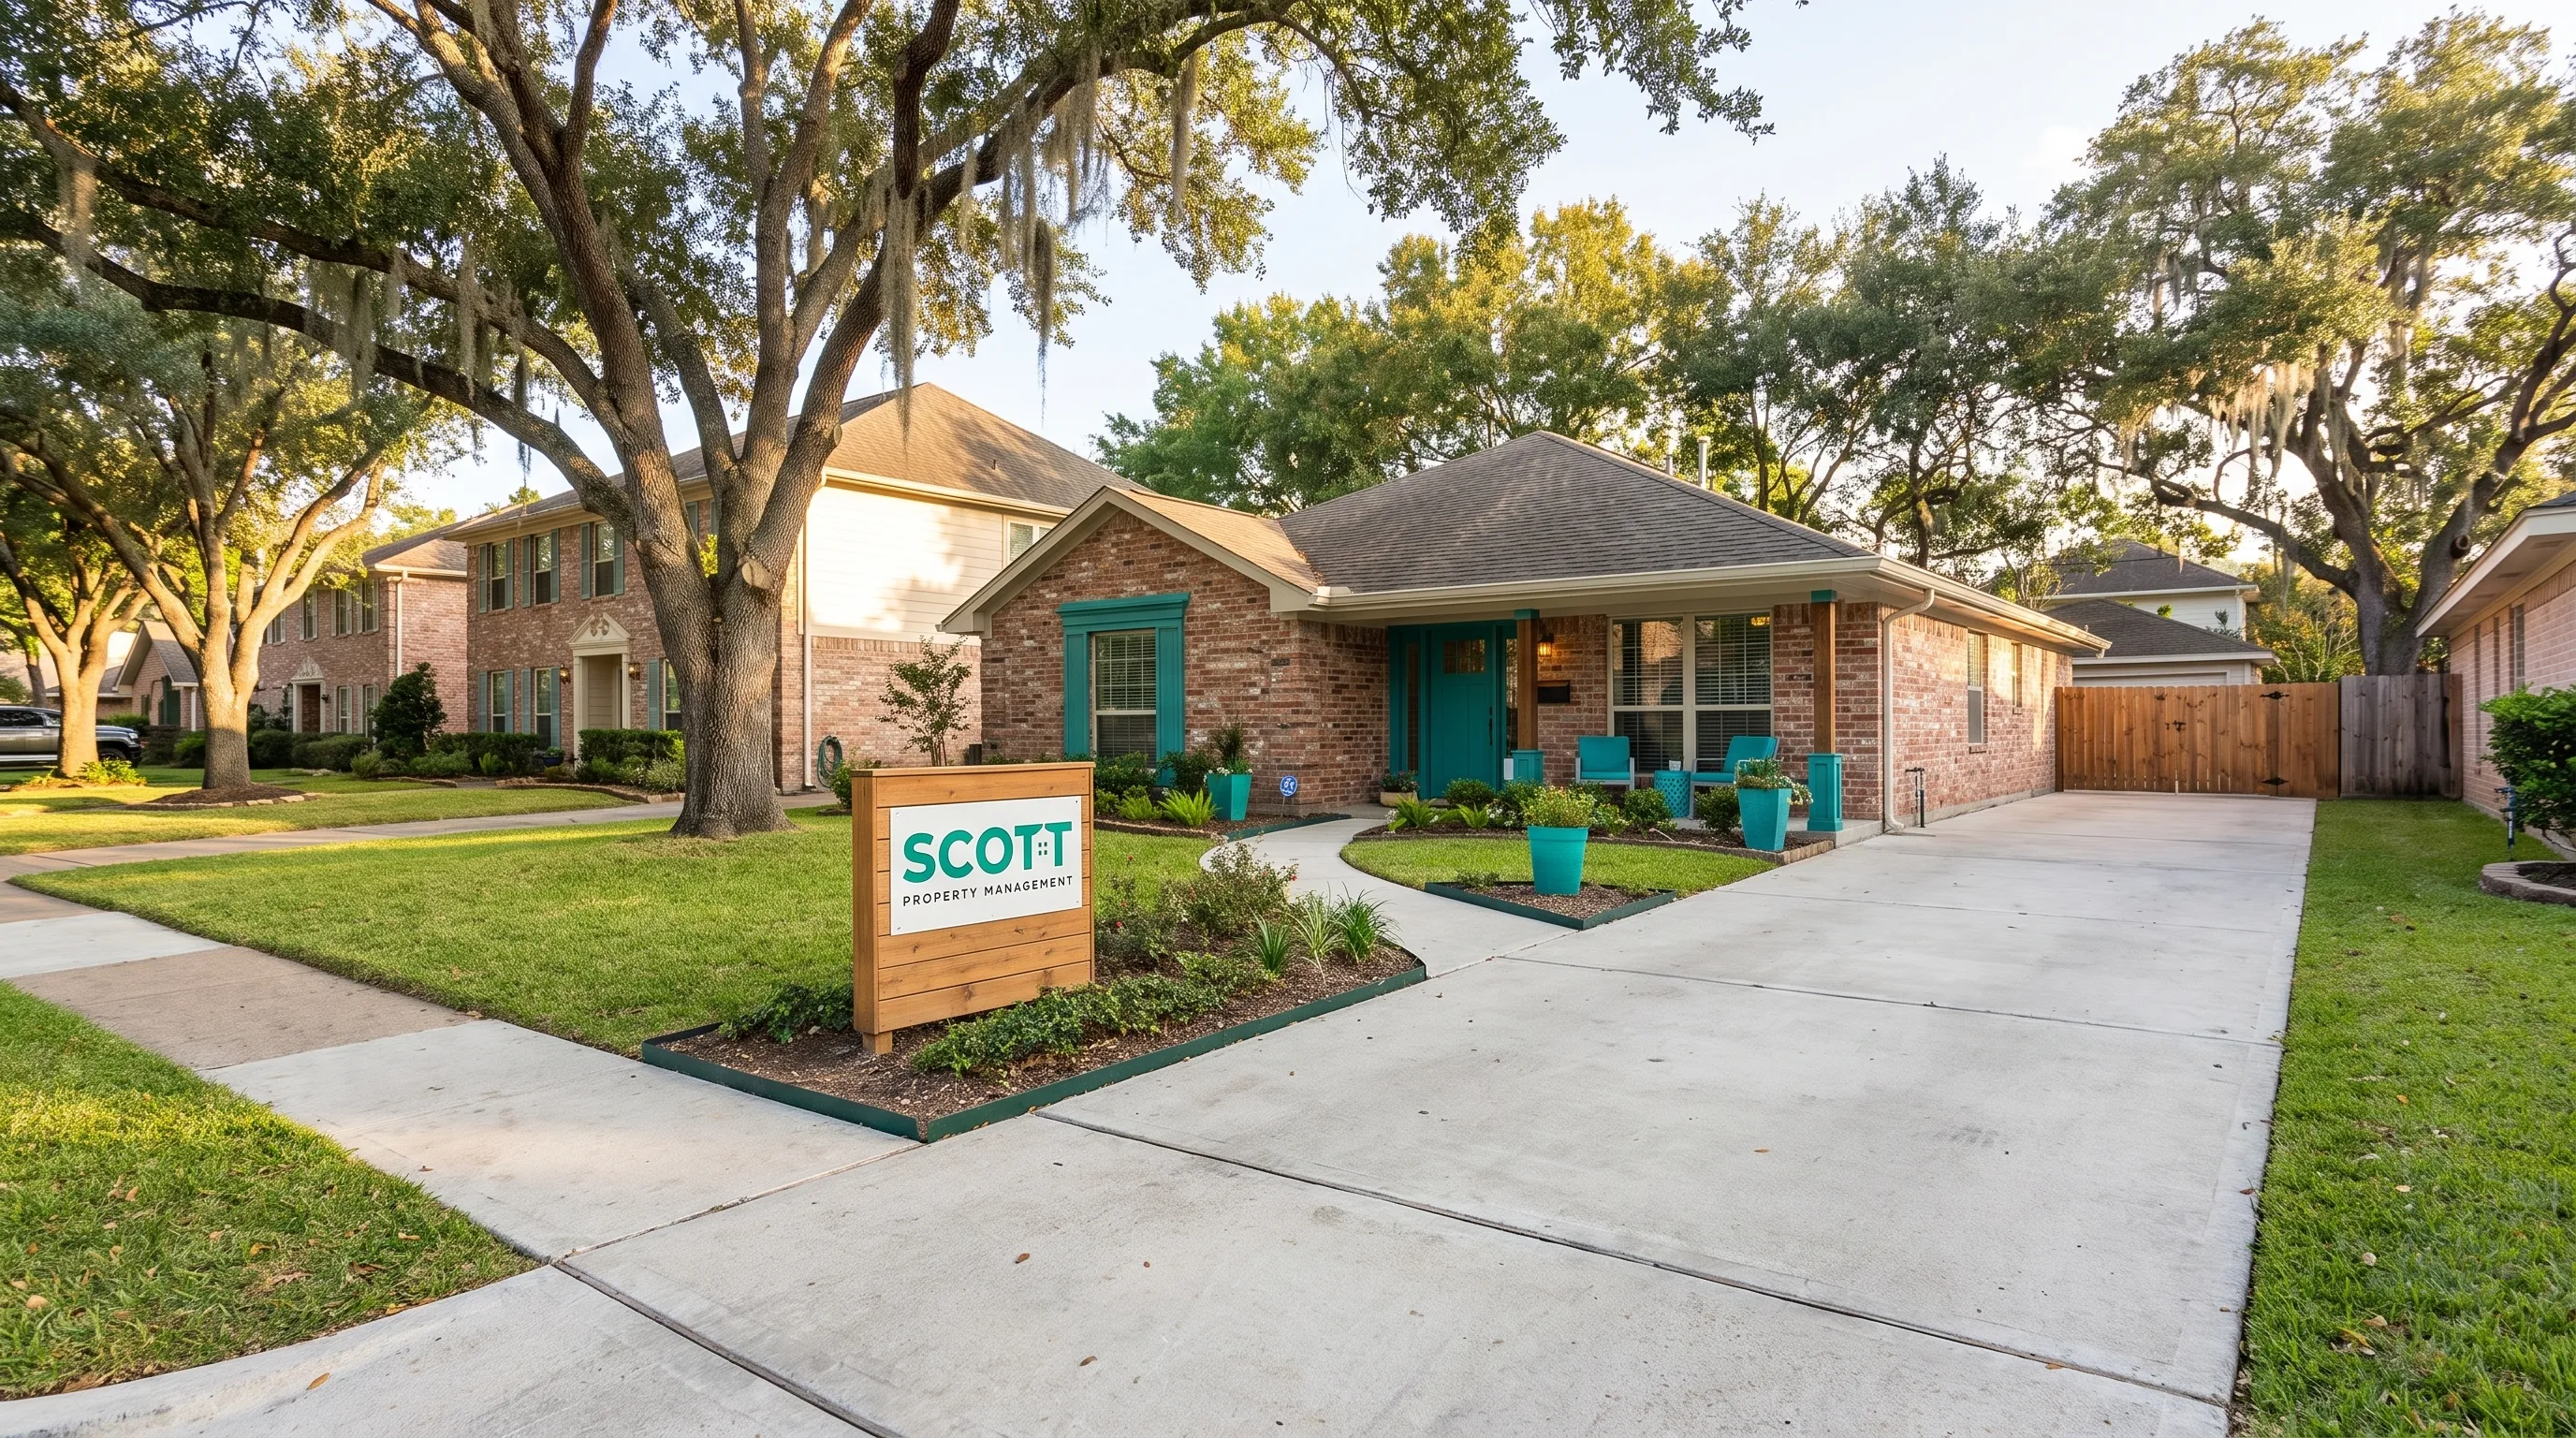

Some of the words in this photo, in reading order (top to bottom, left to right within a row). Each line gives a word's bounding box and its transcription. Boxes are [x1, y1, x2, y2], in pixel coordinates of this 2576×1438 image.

[903, 821, 1072, 883] SCOTT
[903, 888, 977, 906] PROPERTY
[985, 876, 1073, 896] MANAGEMENT
